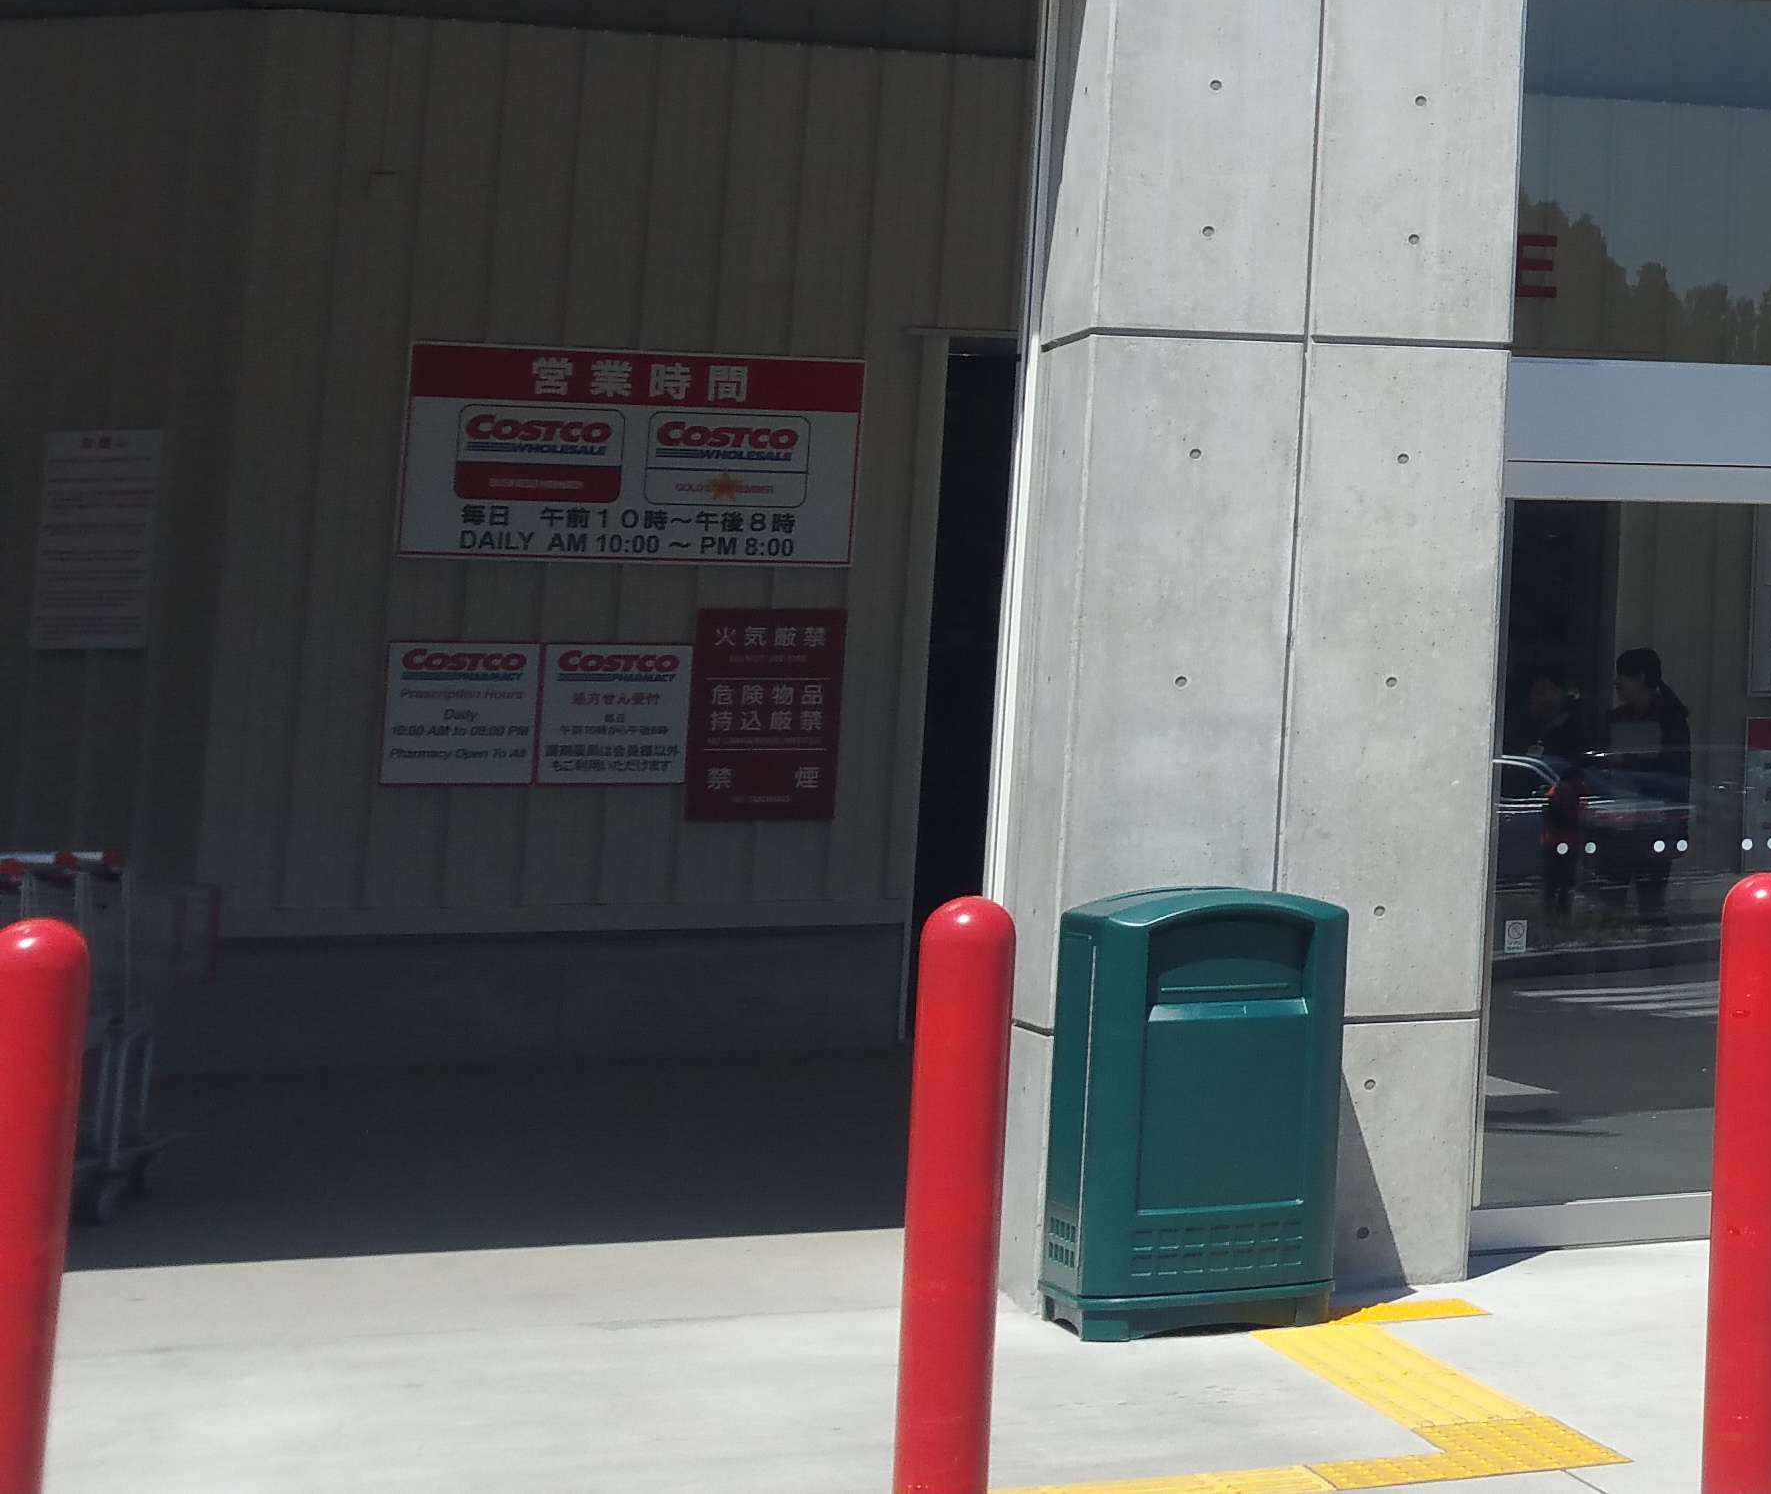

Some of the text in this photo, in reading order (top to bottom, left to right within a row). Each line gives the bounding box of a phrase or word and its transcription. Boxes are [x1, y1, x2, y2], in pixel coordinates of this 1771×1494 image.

[531, 356, 749, 403] 営業時間
[466, 414, 612, 443] COSTCO
[656, 420, 800, 450] COSTCO
[513, 443, 608, 456] WHOLESALE
[699, 448, 793, 461] WHOLESALE
[461, 503, 509, 526] 毎日
[460, 530, 535, 550] DAILY
[547, 533, 587, 552] AM
[596, 533, 660, 554] 10:00
[699, 536, 738, 555] PM
[744, 537, 794, 557] 8:00
[714, 626, 828, 648] 火気厳禁
[402, 648, 527, 672] COSTCO
[557, 649, 680, 673] COSTCO
[711, 683, 824, 706] 危険物品
[443, 708, 479, 722] Daily
[709, 709, 823, 732] 持込厳禁
